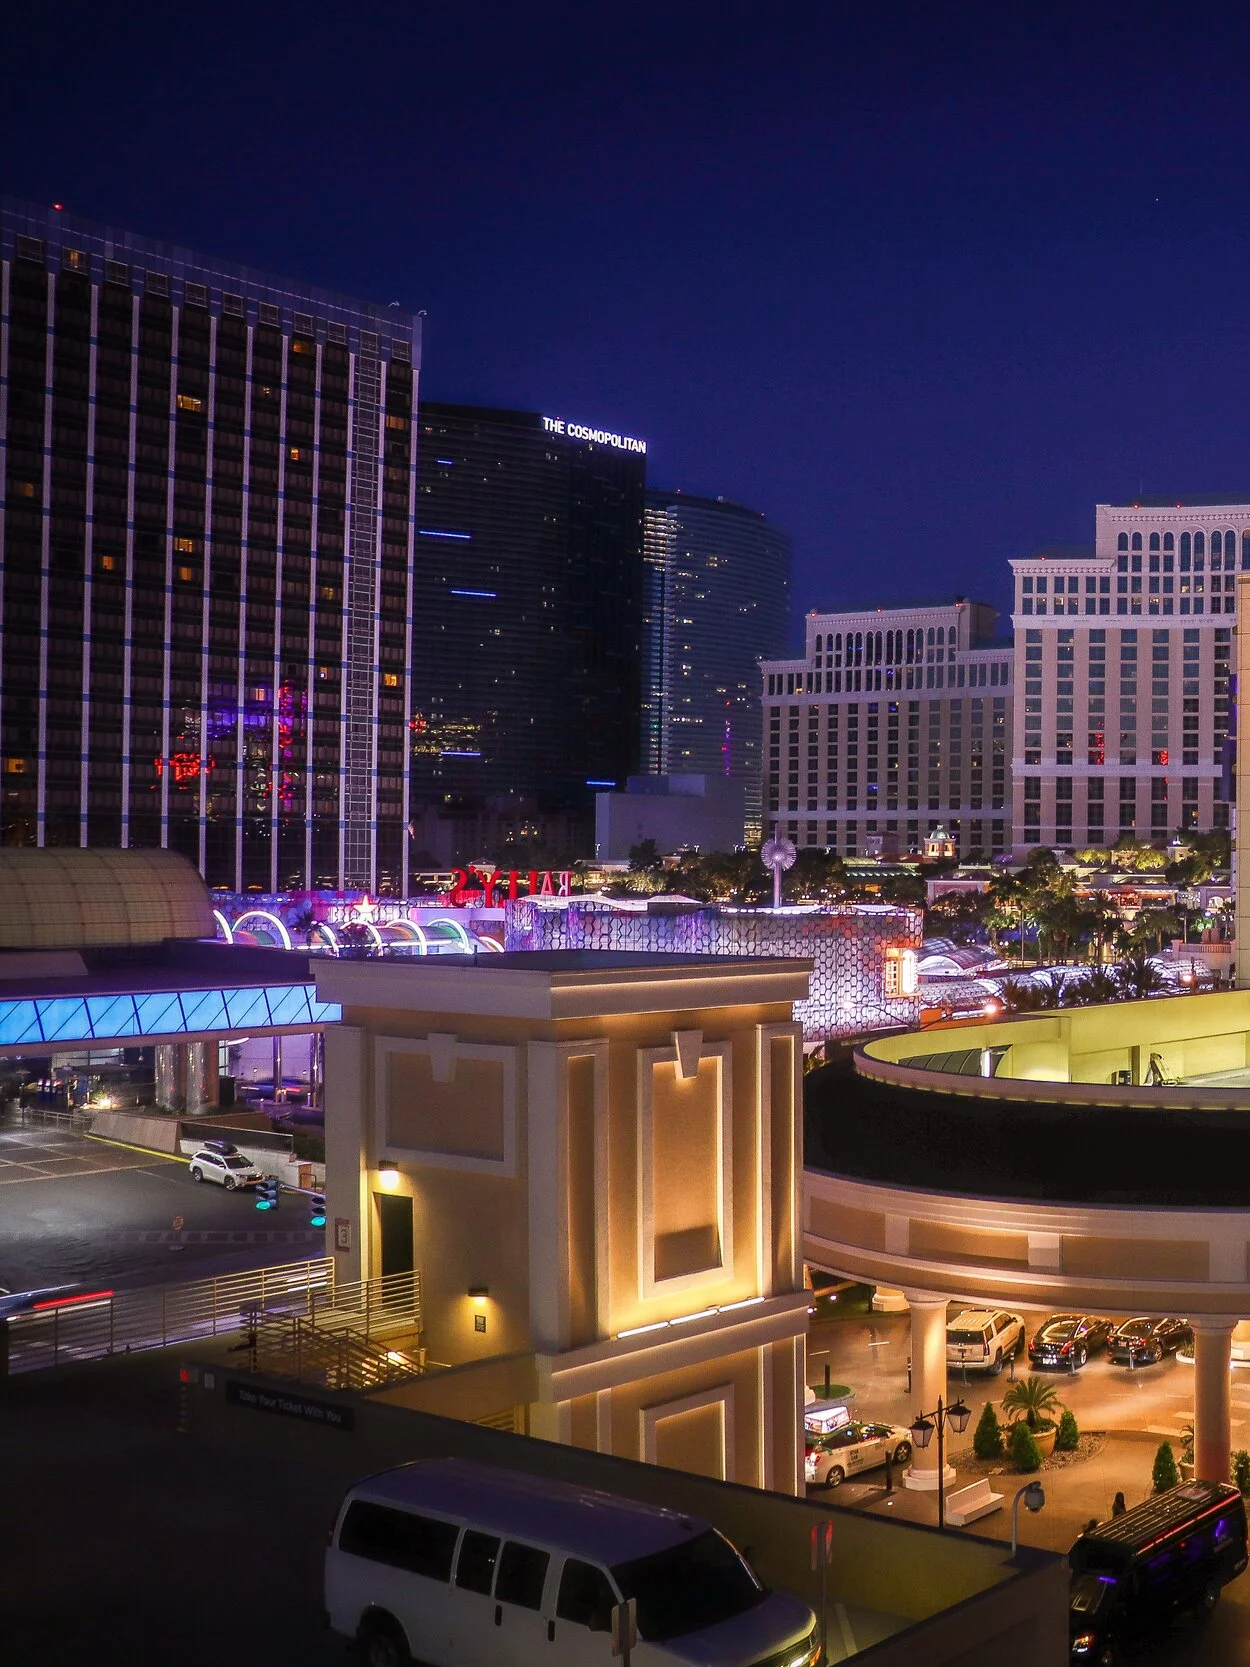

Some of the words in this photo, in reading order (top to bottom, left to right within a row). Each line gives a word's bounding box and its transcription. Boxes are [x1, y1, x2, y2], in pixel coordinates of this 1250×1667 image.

[543, 416, 565, 434] THE
[567, 423, 646, 454] COSMOPOLITAN
[239, 1388, 256, 1403] Take
[257, 1393, 277, 1409] Your
[278, 1398, 302, 1414] Ticket
[303, 1404, 324, 1419] With
[325, 1410, 342, 1423] You
